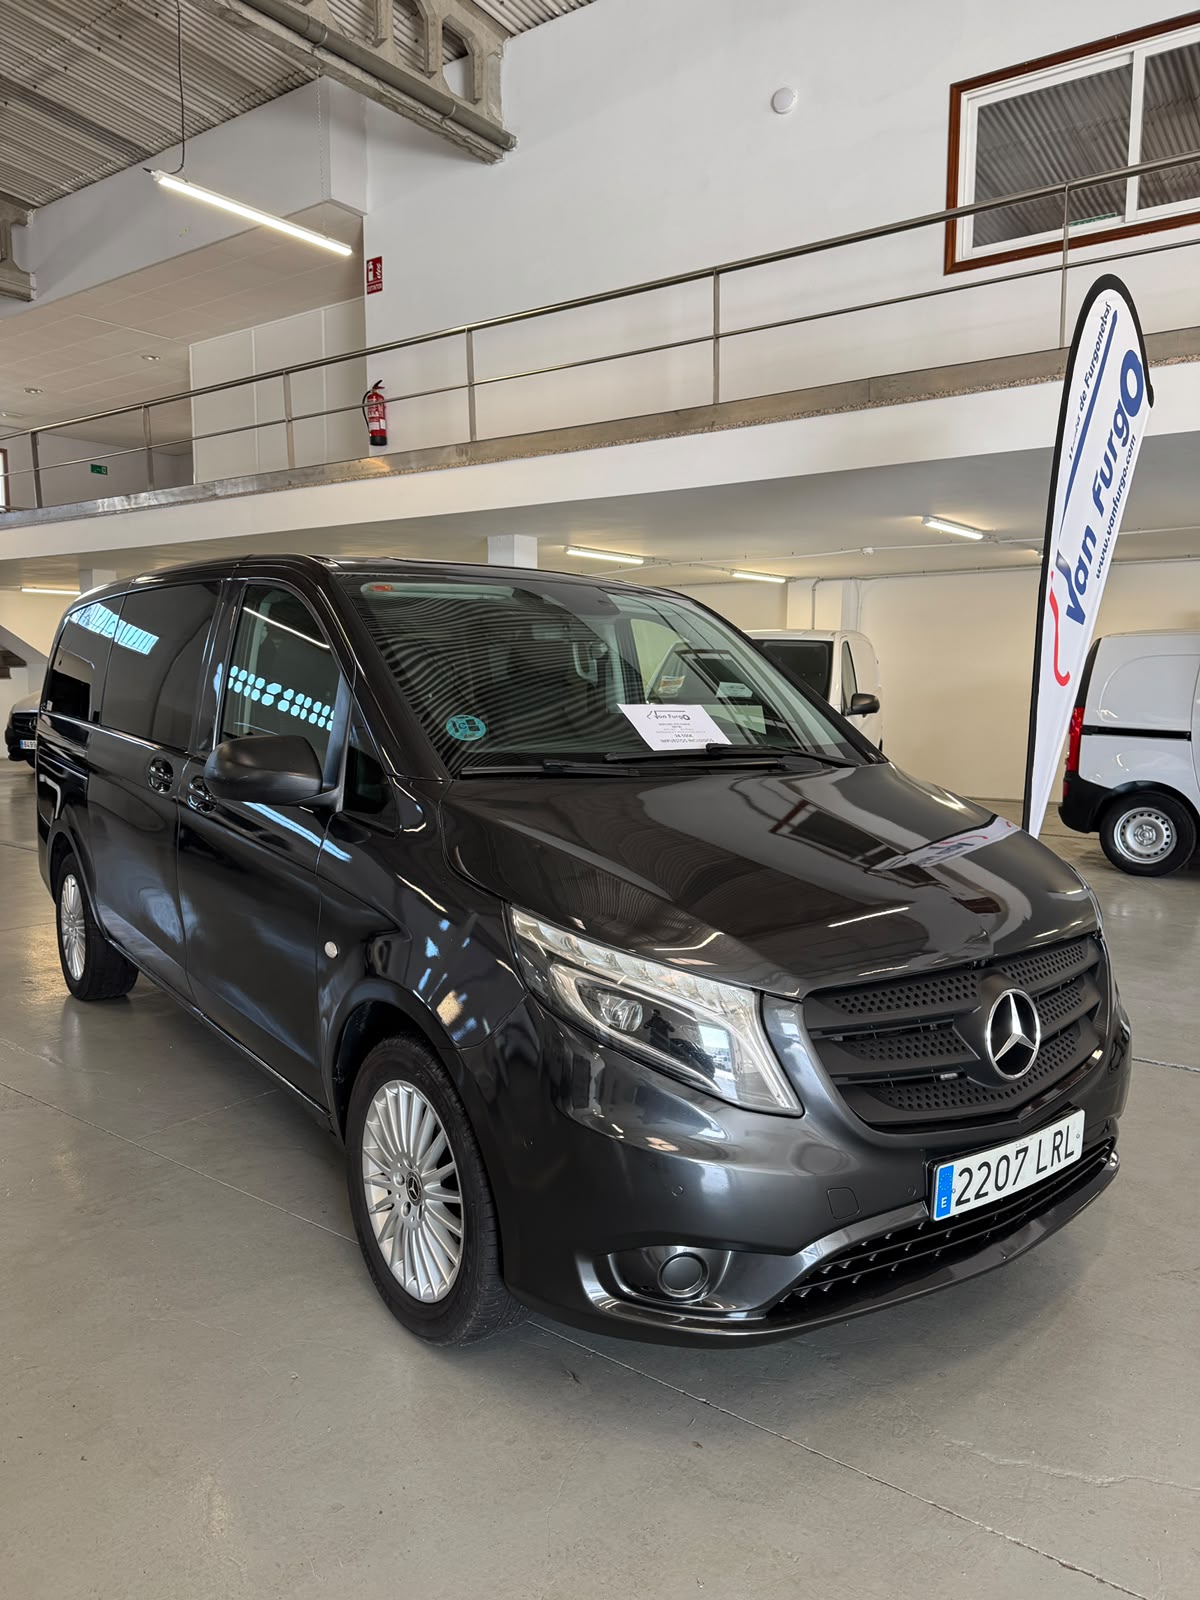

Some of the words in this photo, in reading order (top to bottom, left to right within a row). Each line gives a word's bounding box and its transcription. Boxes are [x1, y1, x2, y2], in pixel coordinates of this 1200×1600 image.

[1079, 390, 1087, 412] de
[1095, 434, 1137, 579] www.vanfurgo.com
[1055, 523, 1096, 626] Van
[941, 1196, 948, 1208] E
[955, 1146, 1029, 1207] 2207
[1035, 1125, 1075, 1175] LRL
